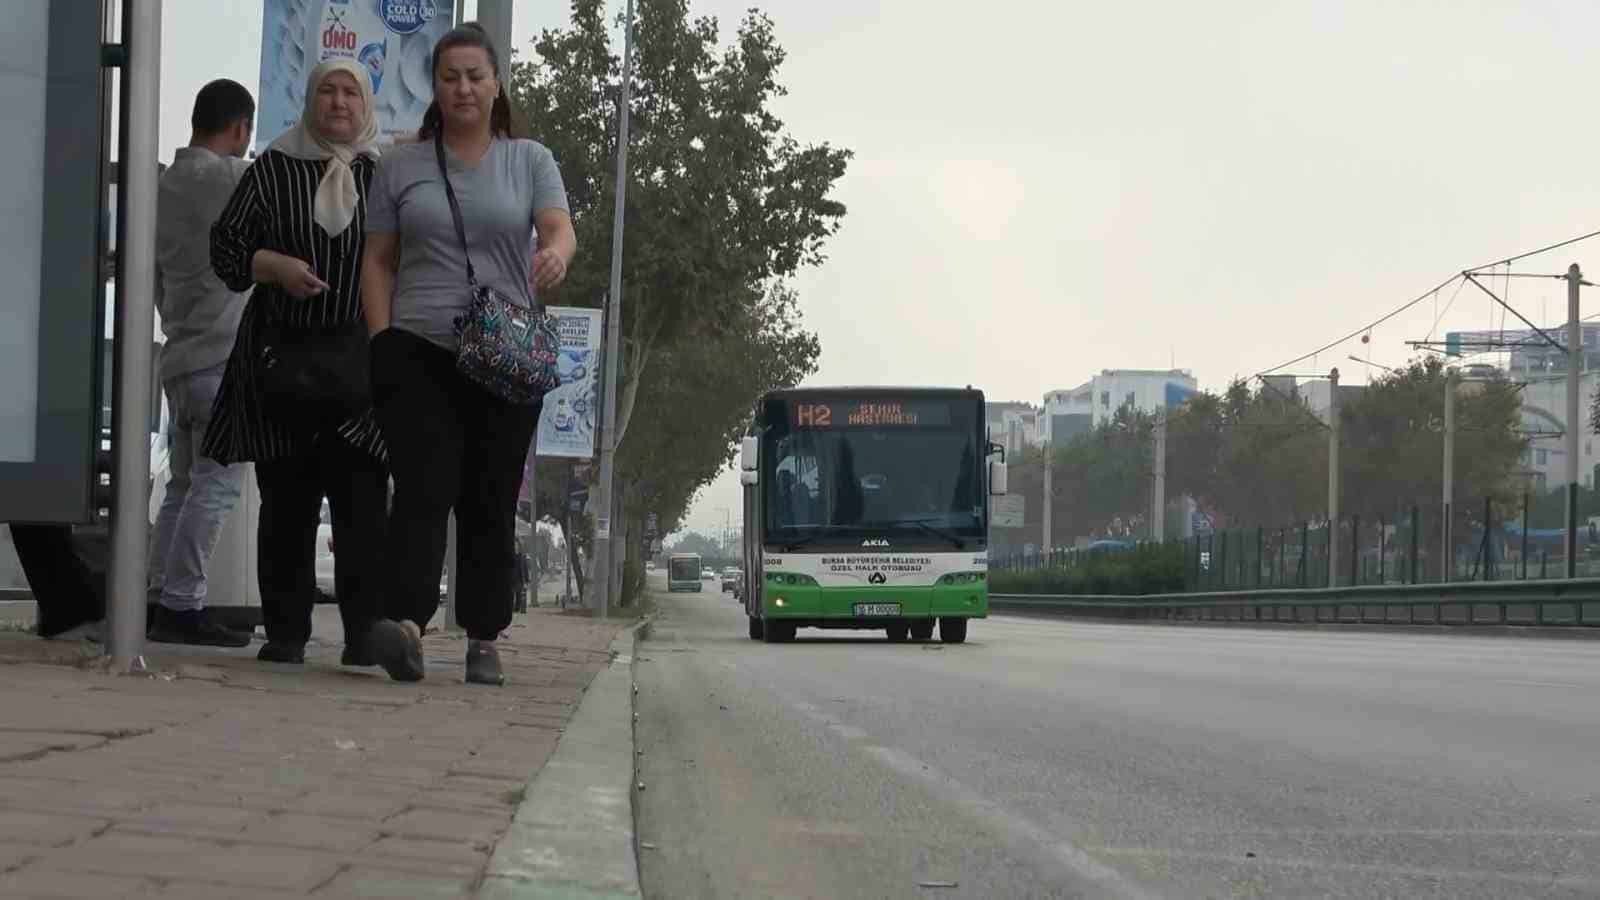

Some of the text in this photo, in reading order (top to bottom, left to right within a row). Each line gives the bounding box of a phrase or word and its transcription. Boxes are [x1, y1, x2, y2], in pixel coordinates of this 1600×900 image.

[387, 5, 417, 15] COLD
[387, 15, 417, 24] POWER
[323, 30, 356, 49] OMO
[798, 404, 832, 425] H2
[822, 556, 845, 564] BURSA
